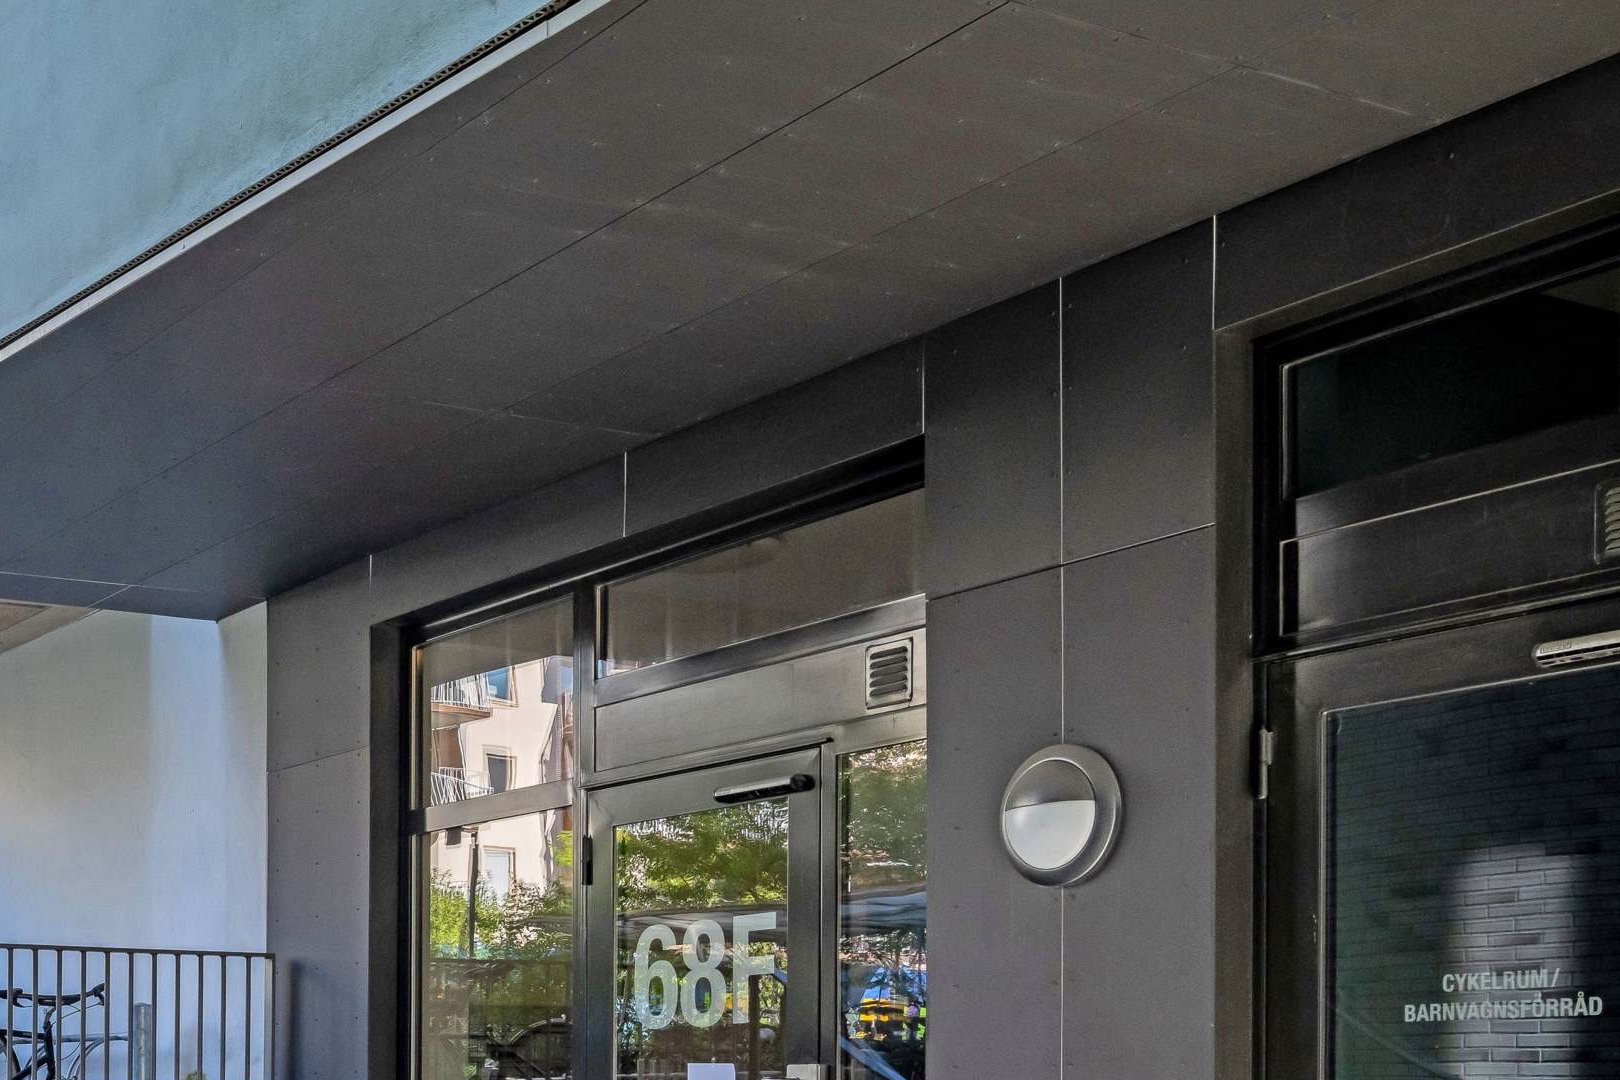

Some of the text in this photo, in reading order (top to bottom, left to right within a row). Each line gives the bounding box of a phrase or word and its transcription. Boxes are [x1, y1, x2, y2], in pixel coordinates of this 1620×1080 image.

[634, 911, 777, 1029] 68F
[1442, 967, 1561, 992] CYKELRUM/
[1404, 991, 1603, 1022] BARNVAGNSFÖRRÅD
